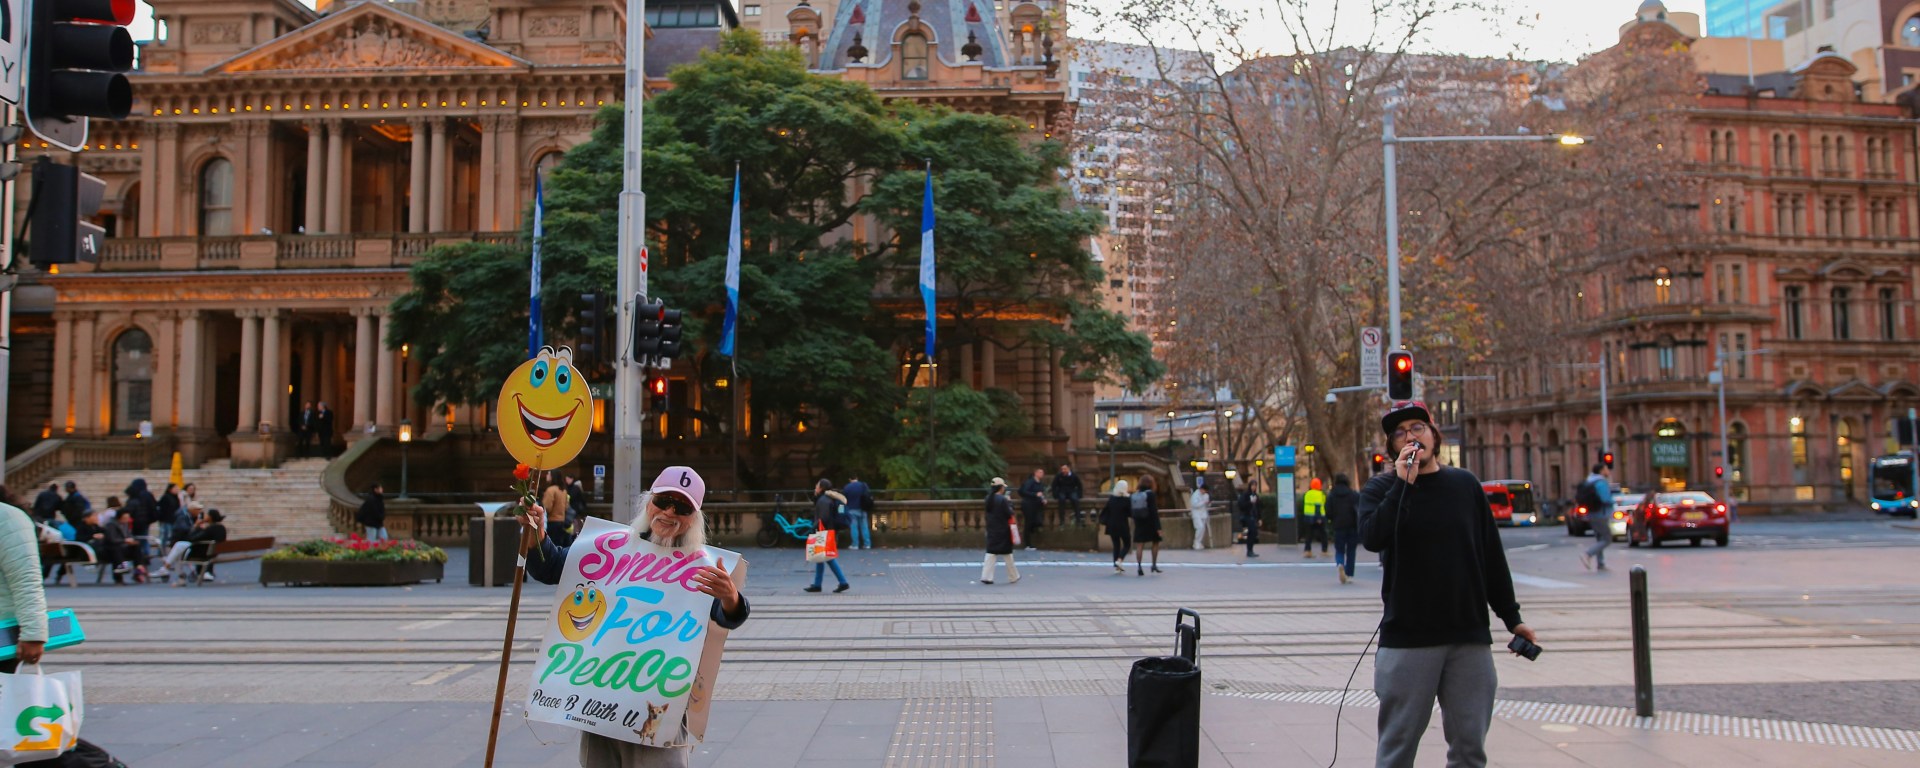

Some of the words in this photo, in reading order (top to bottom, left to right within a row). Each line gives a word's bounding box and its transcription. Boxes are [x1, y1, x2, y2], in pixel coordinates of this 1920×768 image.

[591, 386, 601, 397] St
[1652, 443, 1686, 455] OPALS
[680, 471, 692, 488] b
[578, 531, 708, 593] Smile
[591, 586, 703, 647] For
[531, 689, 562, 709] Peace
[564, 694, 580, 711] B
[581, 698, 619, 722] With
[622, 709, 640, 728] U
